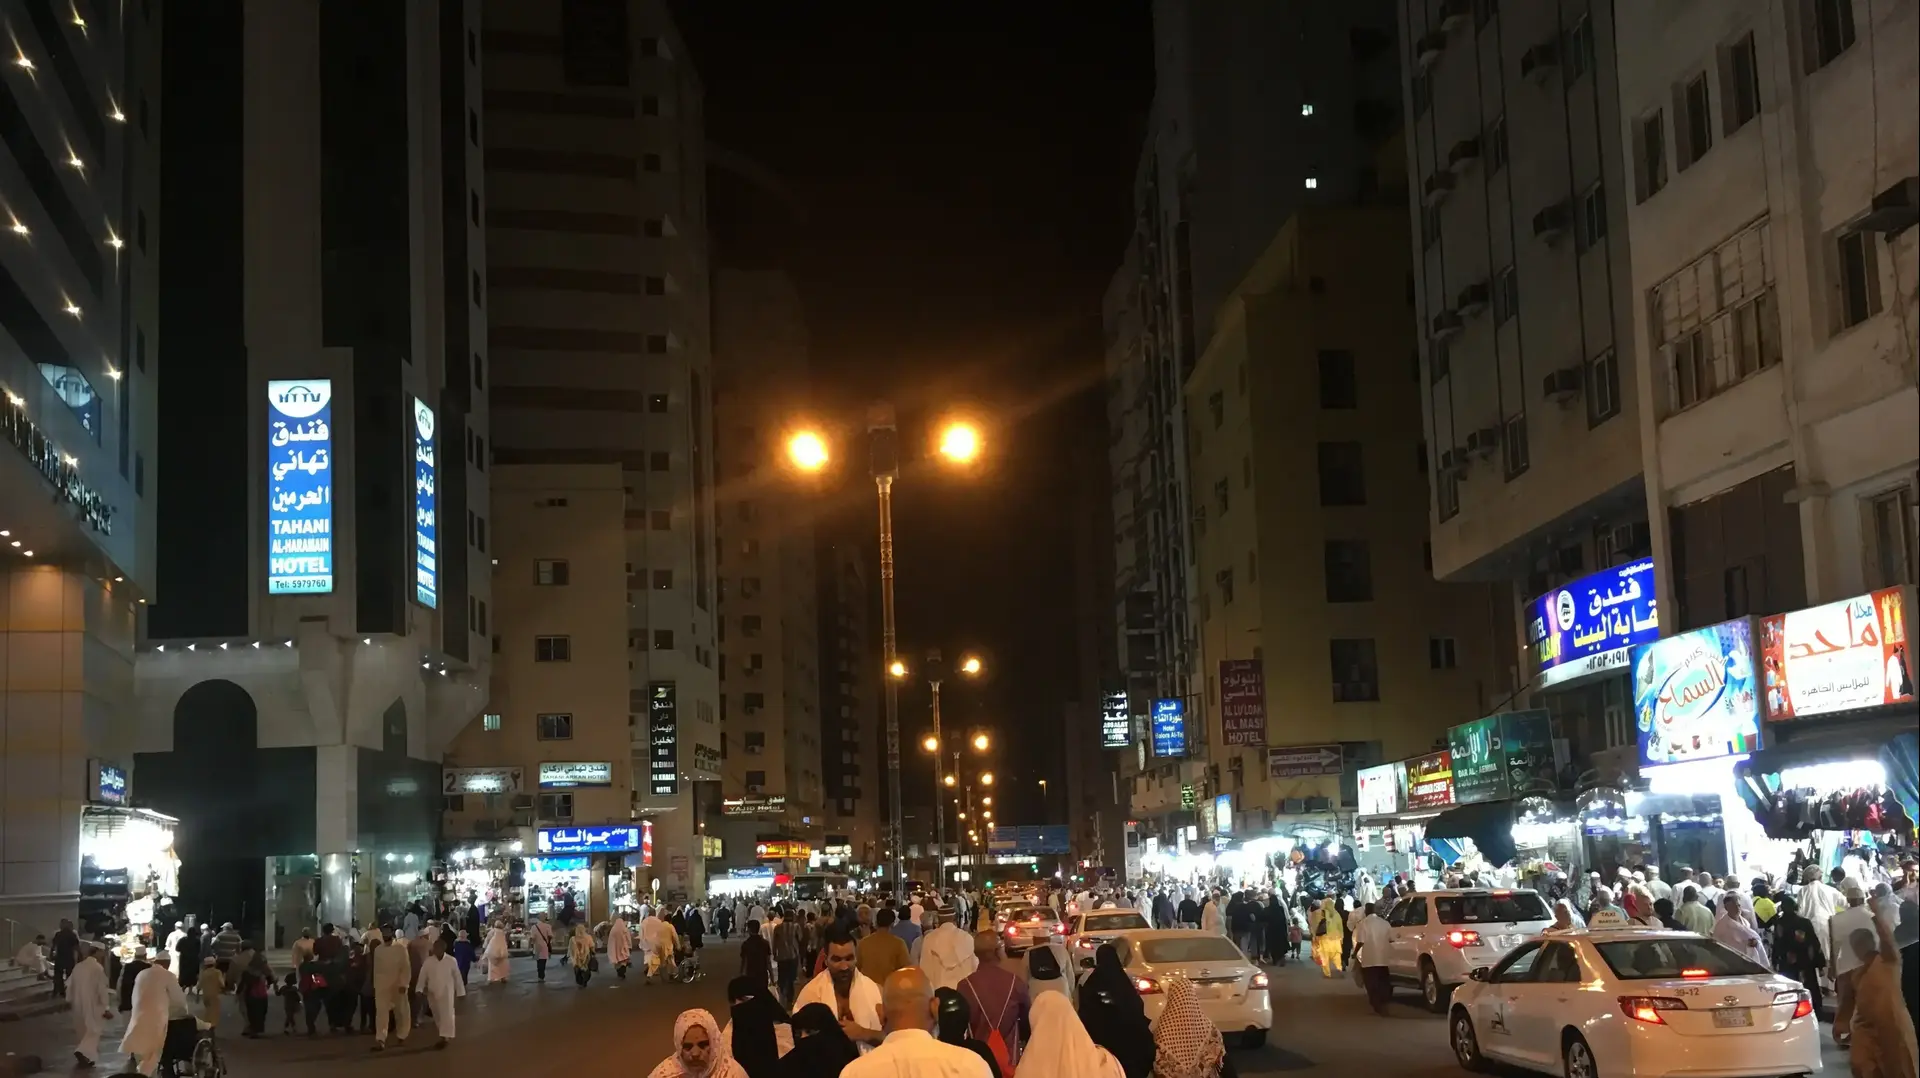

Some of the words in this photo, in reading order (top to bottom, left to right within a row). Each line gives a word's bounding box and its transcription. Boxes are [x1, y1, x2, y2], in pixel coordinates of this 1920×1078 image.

[271, 418, 330, 447] فندق
[415, 437, 434, 468] فندق
[271, 449, 329, 481] تهاني
[416, 468, 434, 497] تهاني
[271, 485, 330, 513] الحرمين
[271, 519, 330, 535] TAHANI
[271, 538, 330, 554] AL-HARAMAIN
[271, 557, 330, 574] HOTEL
[275, 580, 290, 589] Tel:
[292, 579, 326, 589] 5979760
[1588, 577, 1641, 617] فندق
[1573, 612, 1612, 651] البيت
[1789, 602, 1879, 663] ماجد
[1659, 659, 1724, 725] السماح
[652, 701, 674, 710] فندق
[1158, 700, 1176, 712] فندق
[1102, 712, 1128, 721] مكة
[1225, 719, 1238, 731] AL
[1239, 718, 1264, 730] MASI
[651, 736, 676, 746] الخليل
[1228, 731, 1262, 743] HOTEL
[1484, 728, 1501, 761] دار
[564, 764, 587, 774] تهاني
[588, 764, 608, 773] فندق
[1457, 768, 1469, 778] DAR
[445, 772, 456, 793] 2
[552, 828, 611, 846] جوالك
[1673, 987, 1700, 997] 39-12
